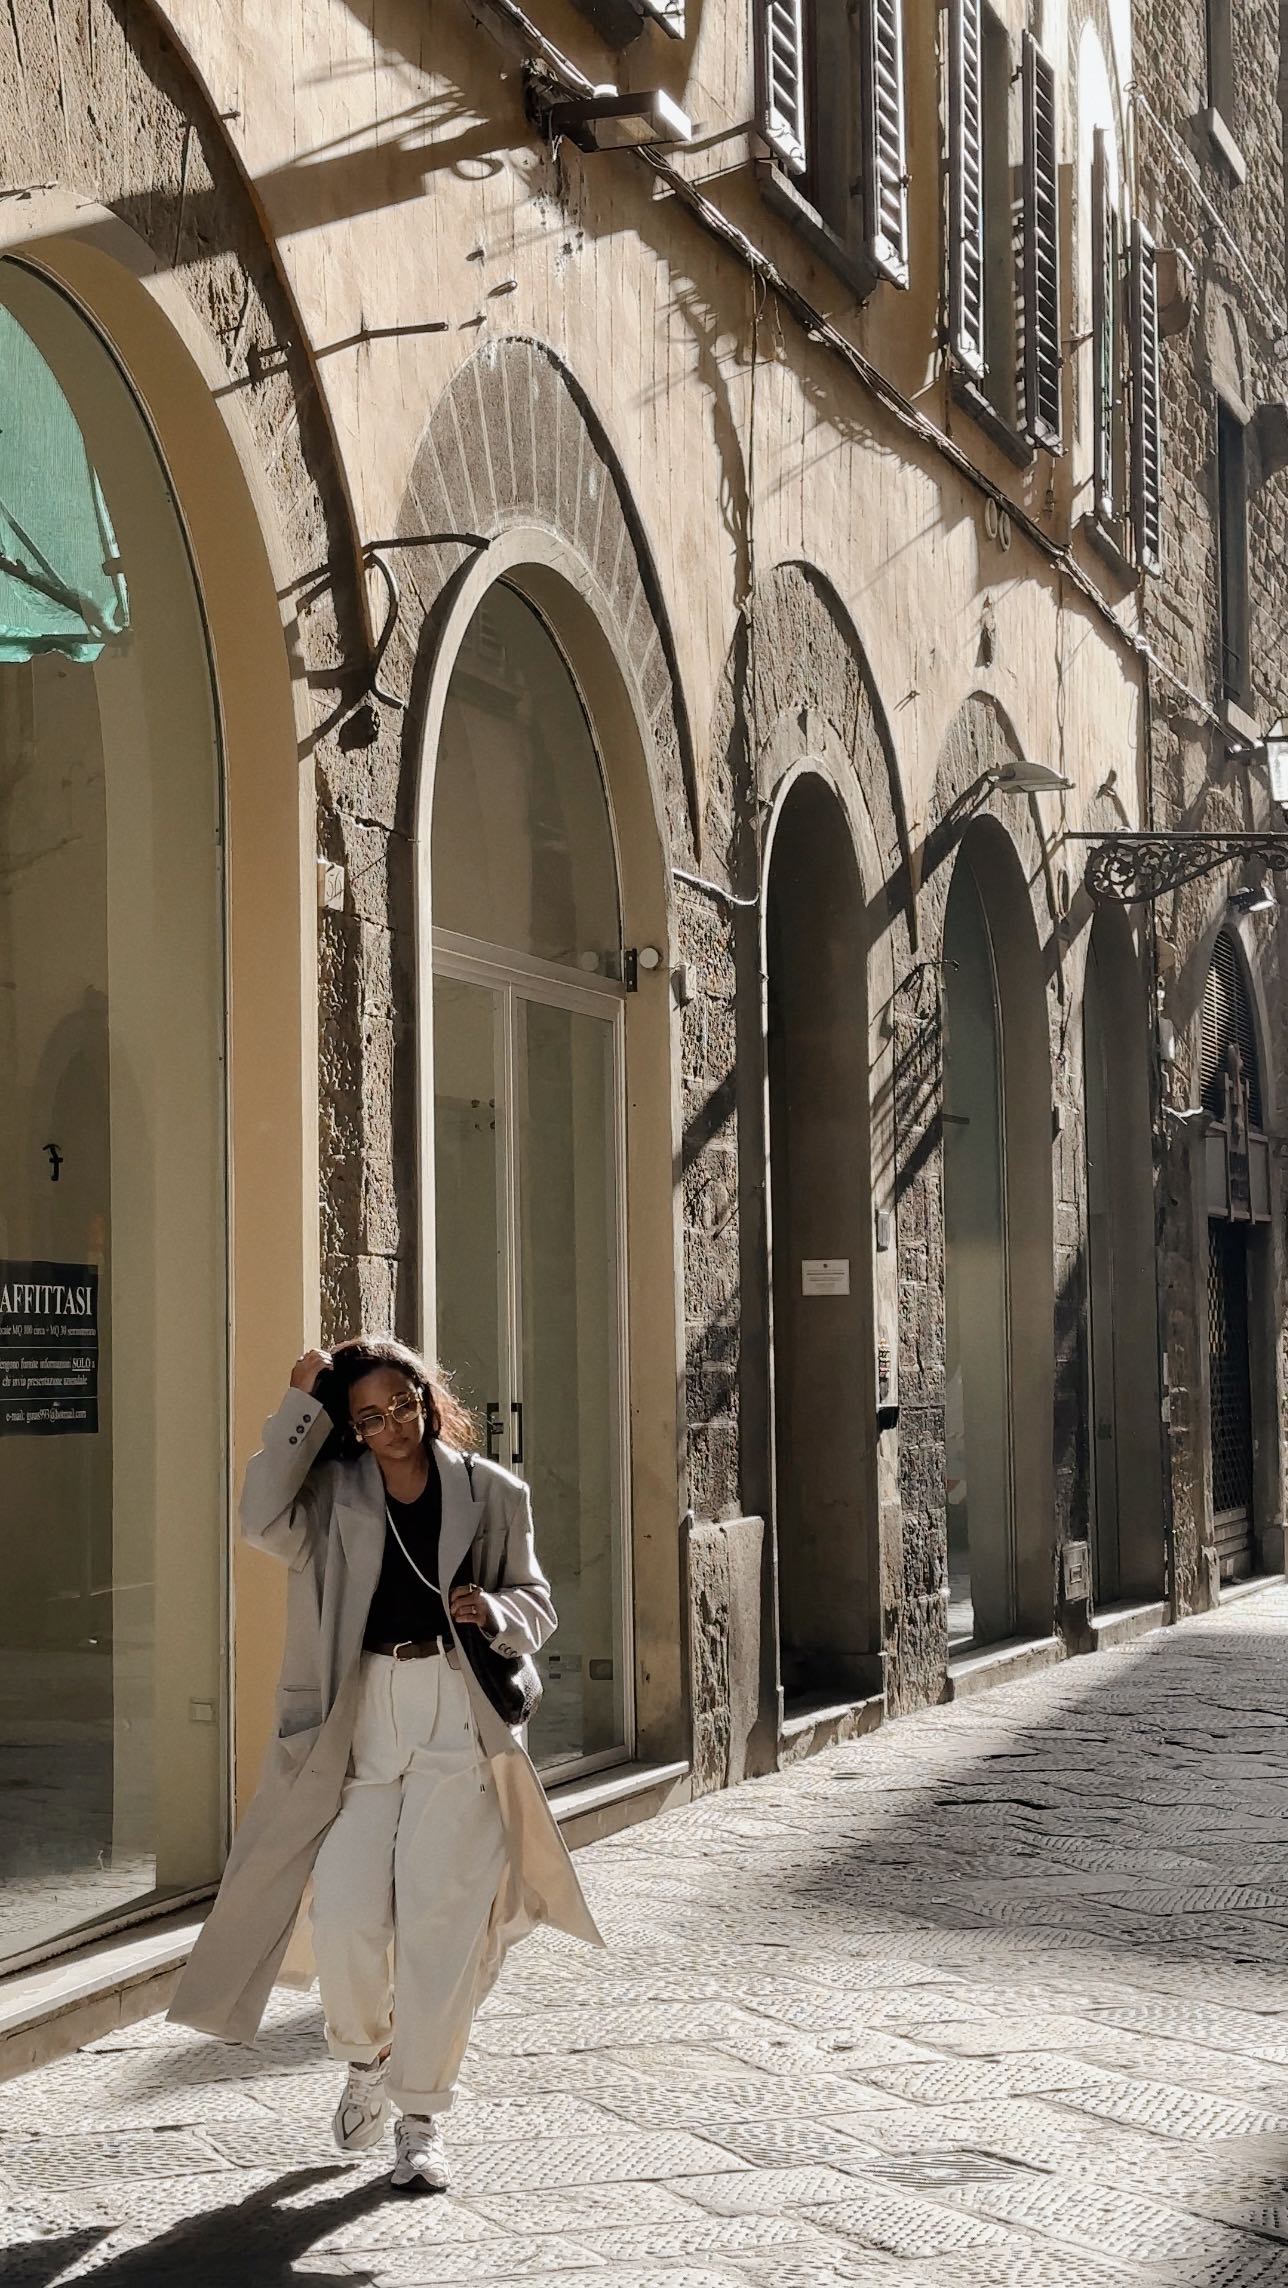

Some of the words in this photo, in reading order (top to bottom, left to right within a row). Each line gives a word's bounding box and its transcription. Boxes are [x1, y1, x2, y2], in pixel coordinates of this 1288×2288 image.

[0, 1284, 92, 1316] AFFITTASI
[13, 1325, 22, 1336] MQ
[50, 1325, 60, 1337] MQ
[72, 1357, 91, 1372] SOLO
